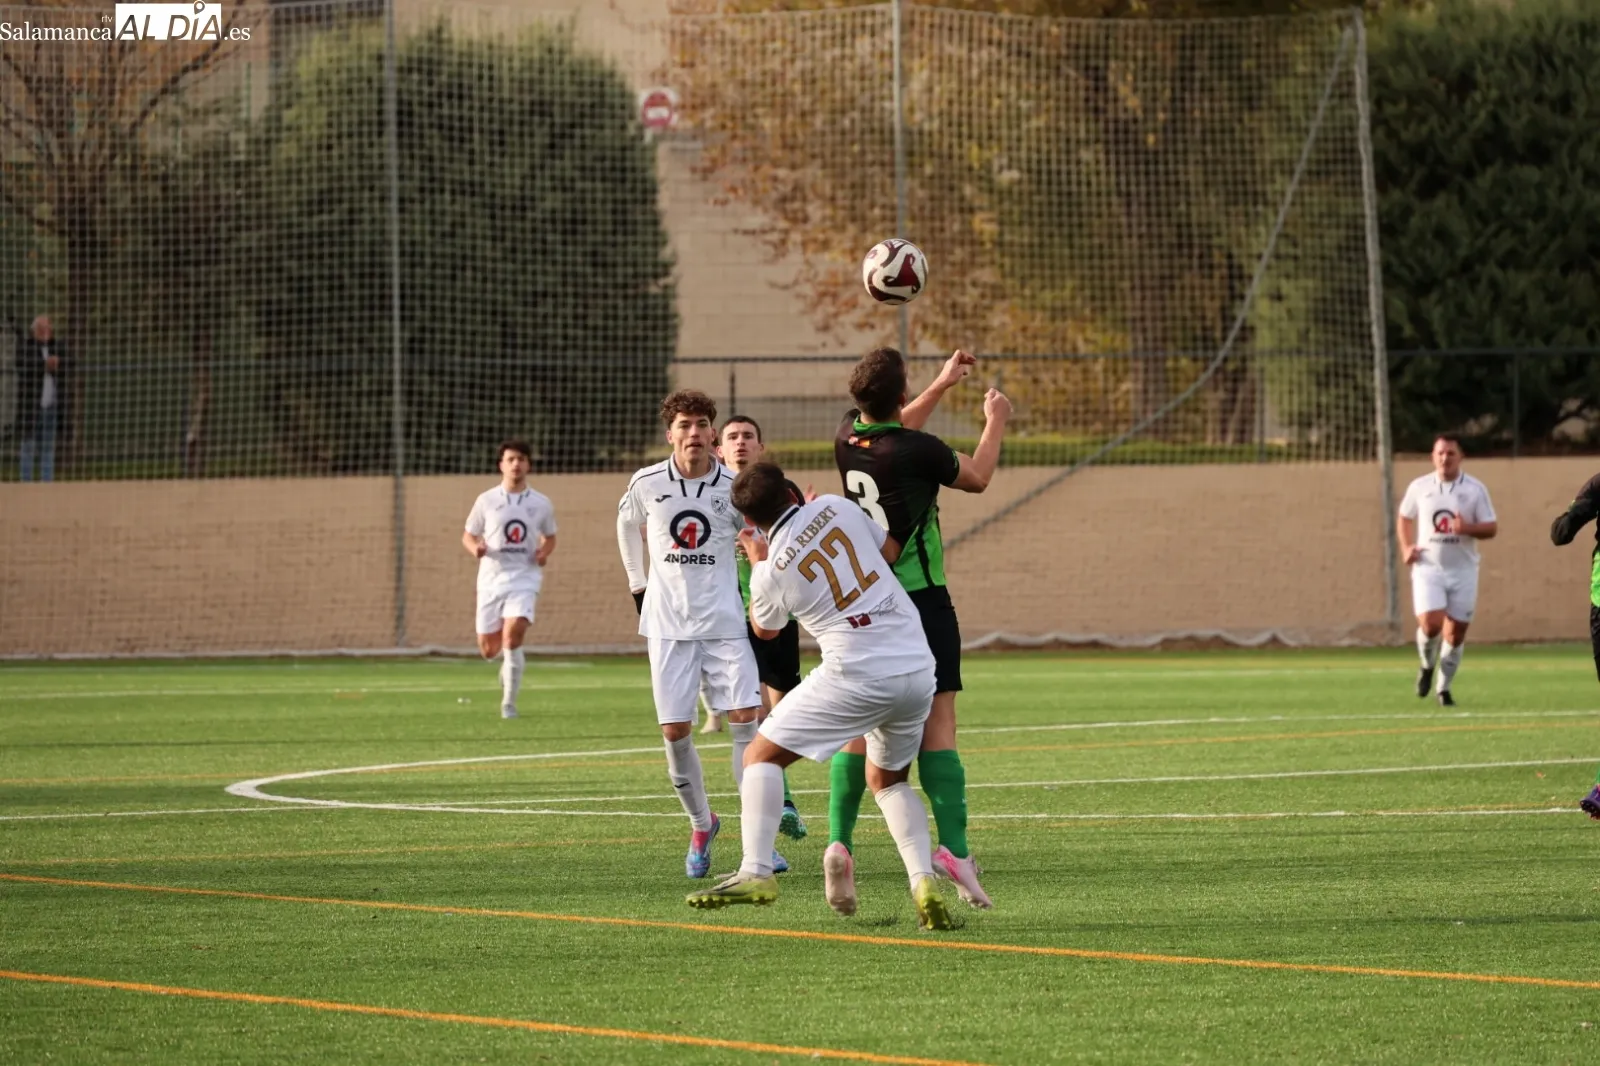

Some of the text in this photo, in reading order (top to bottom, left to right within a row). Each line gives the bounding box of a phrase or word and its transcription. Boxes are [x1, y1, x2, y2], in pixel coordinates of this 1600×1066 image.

[846, 469, 890, 531] 3
[775, 505, 838, 571] C.D. RIBERT
[797, 526, 880, 612] 22
